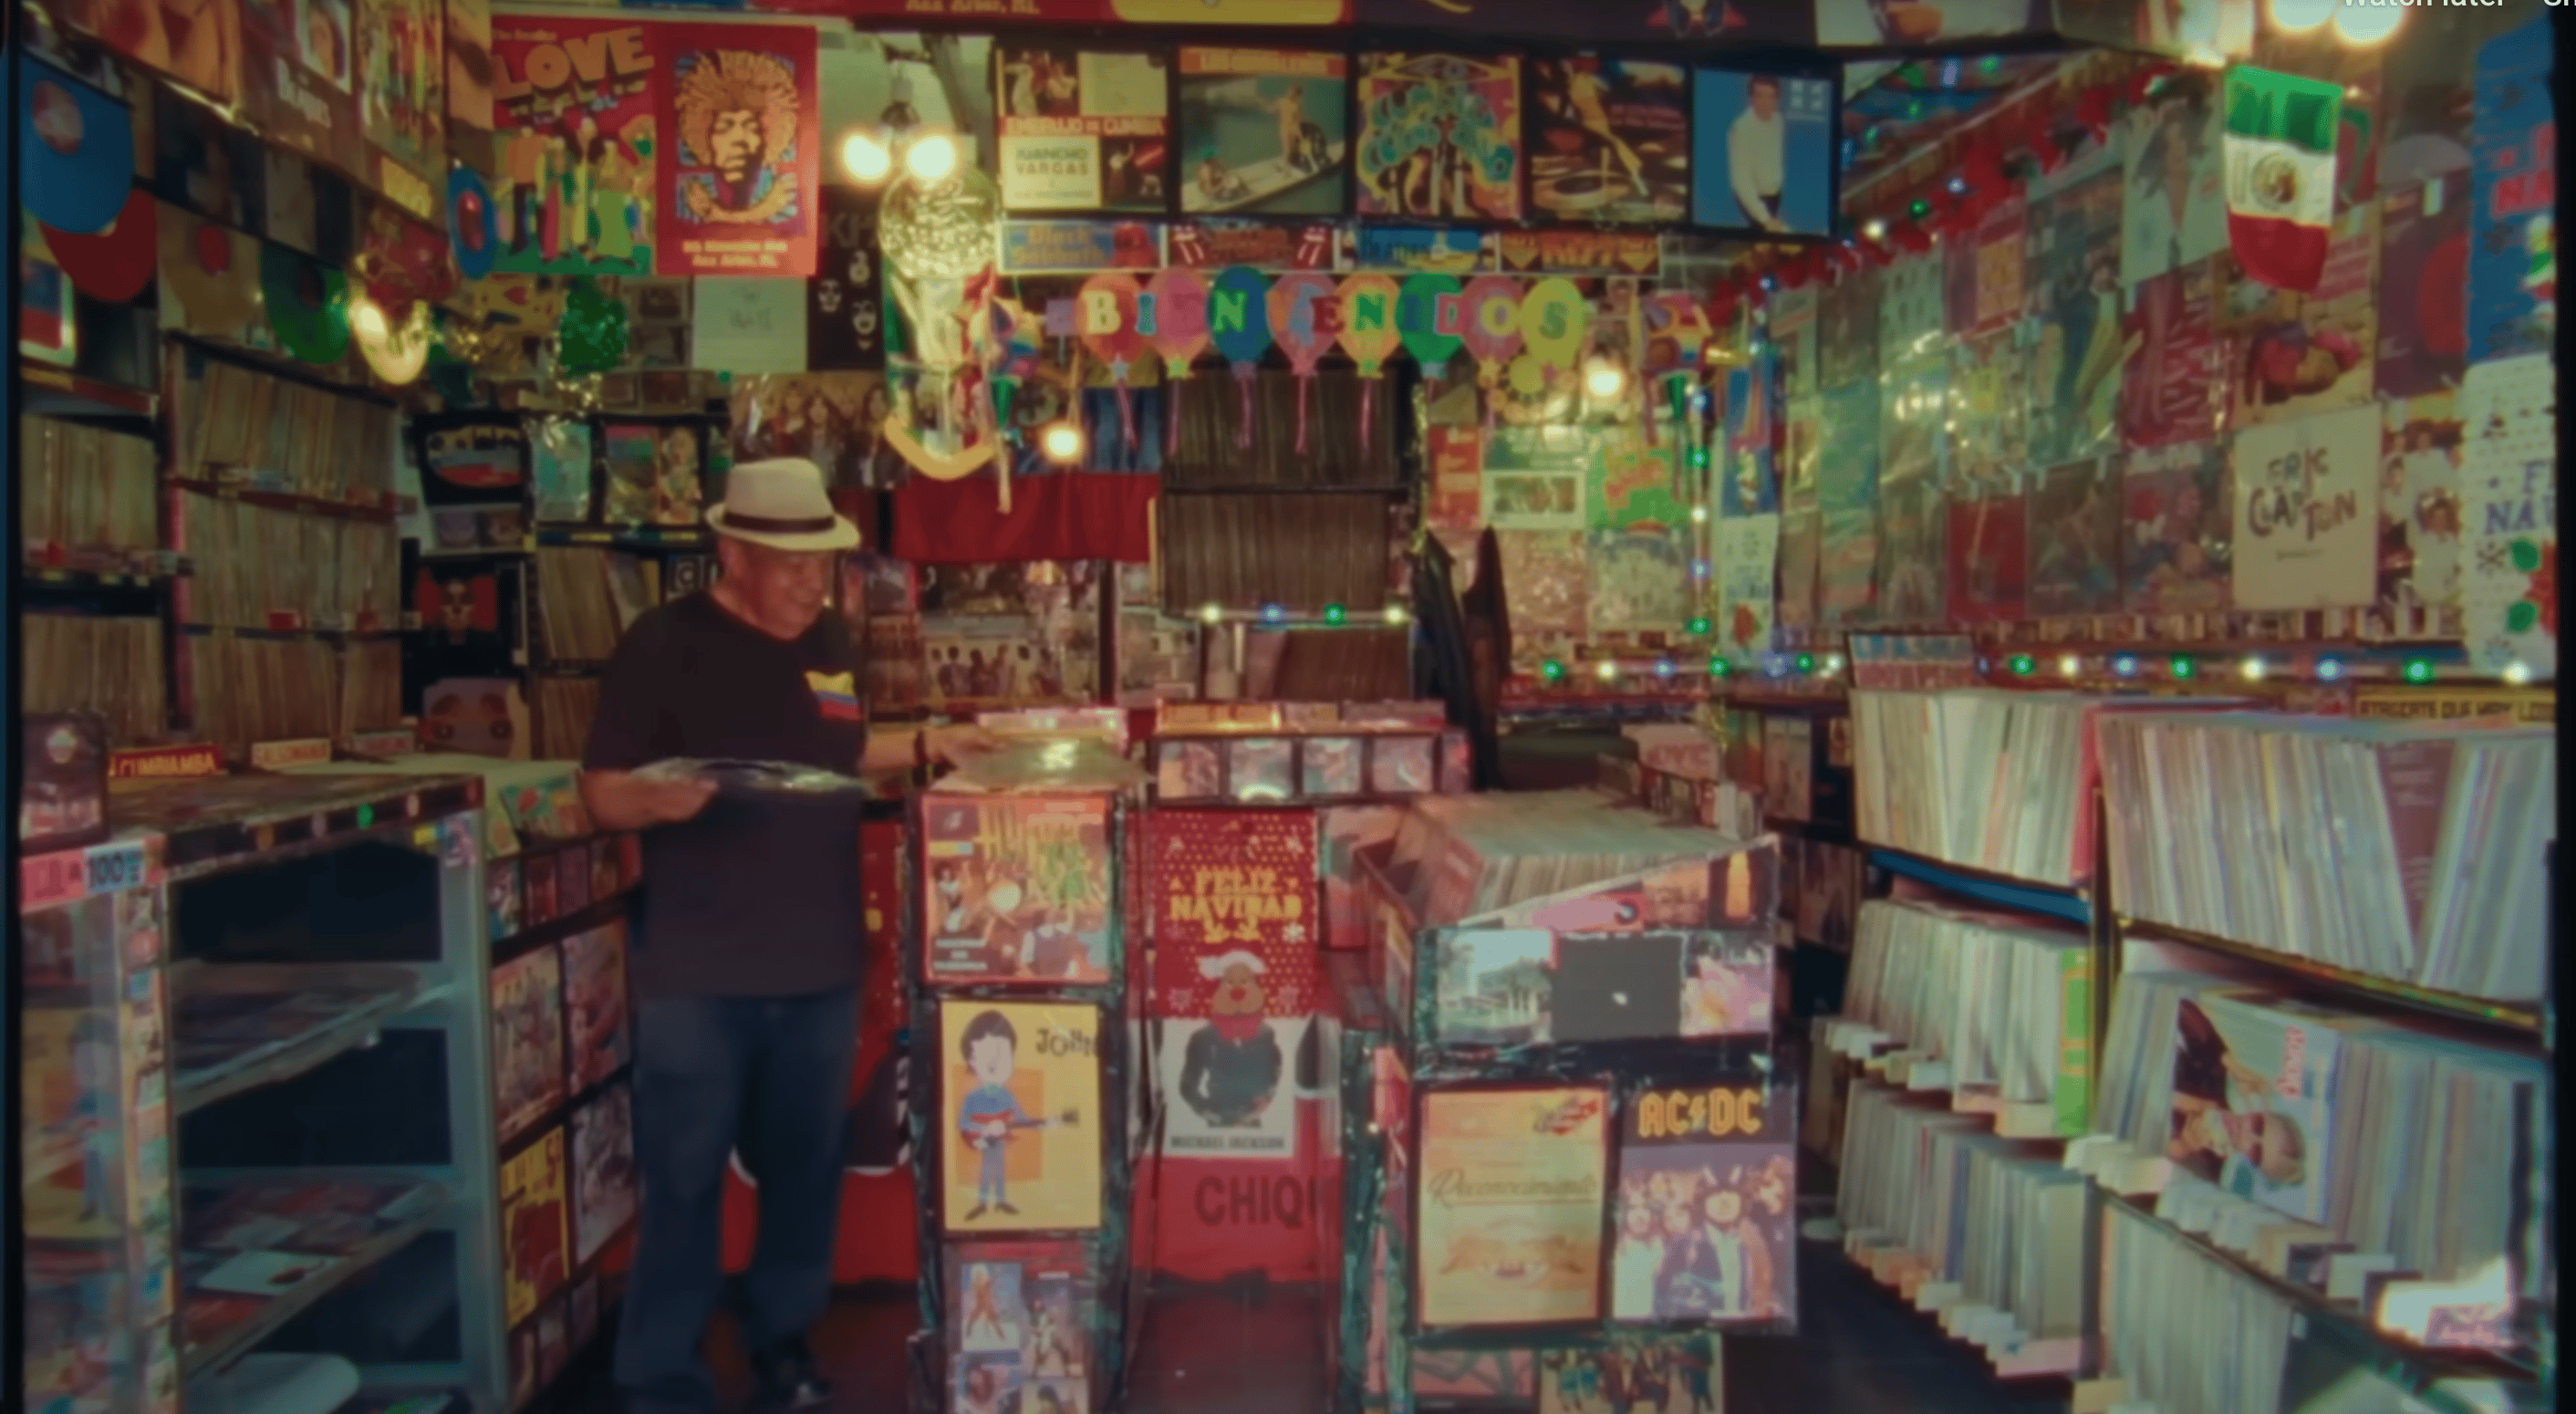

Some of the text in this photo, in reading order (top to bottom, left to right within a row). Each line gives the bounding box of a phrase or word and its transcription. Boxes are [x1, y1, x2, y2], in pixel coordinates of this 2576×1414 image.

[491, 26, 655, 101] LOVE
[1016, 162, 1088, 175] VARGAS
[1083, 284, 1568, 345] BIENVENIDOS
[2267, 447, 2329, 493] ERIC
[2248, 489, 2356, 541] CLAPTON
[1194, 866, 1277, 894] FELIZ
[1169, 893, 1304, 922] NAVIDAD
[1035, 1027, 1098, 1058] JOHN
[1170, 1135, 1285, 1149] MICHAEL JACKSON
